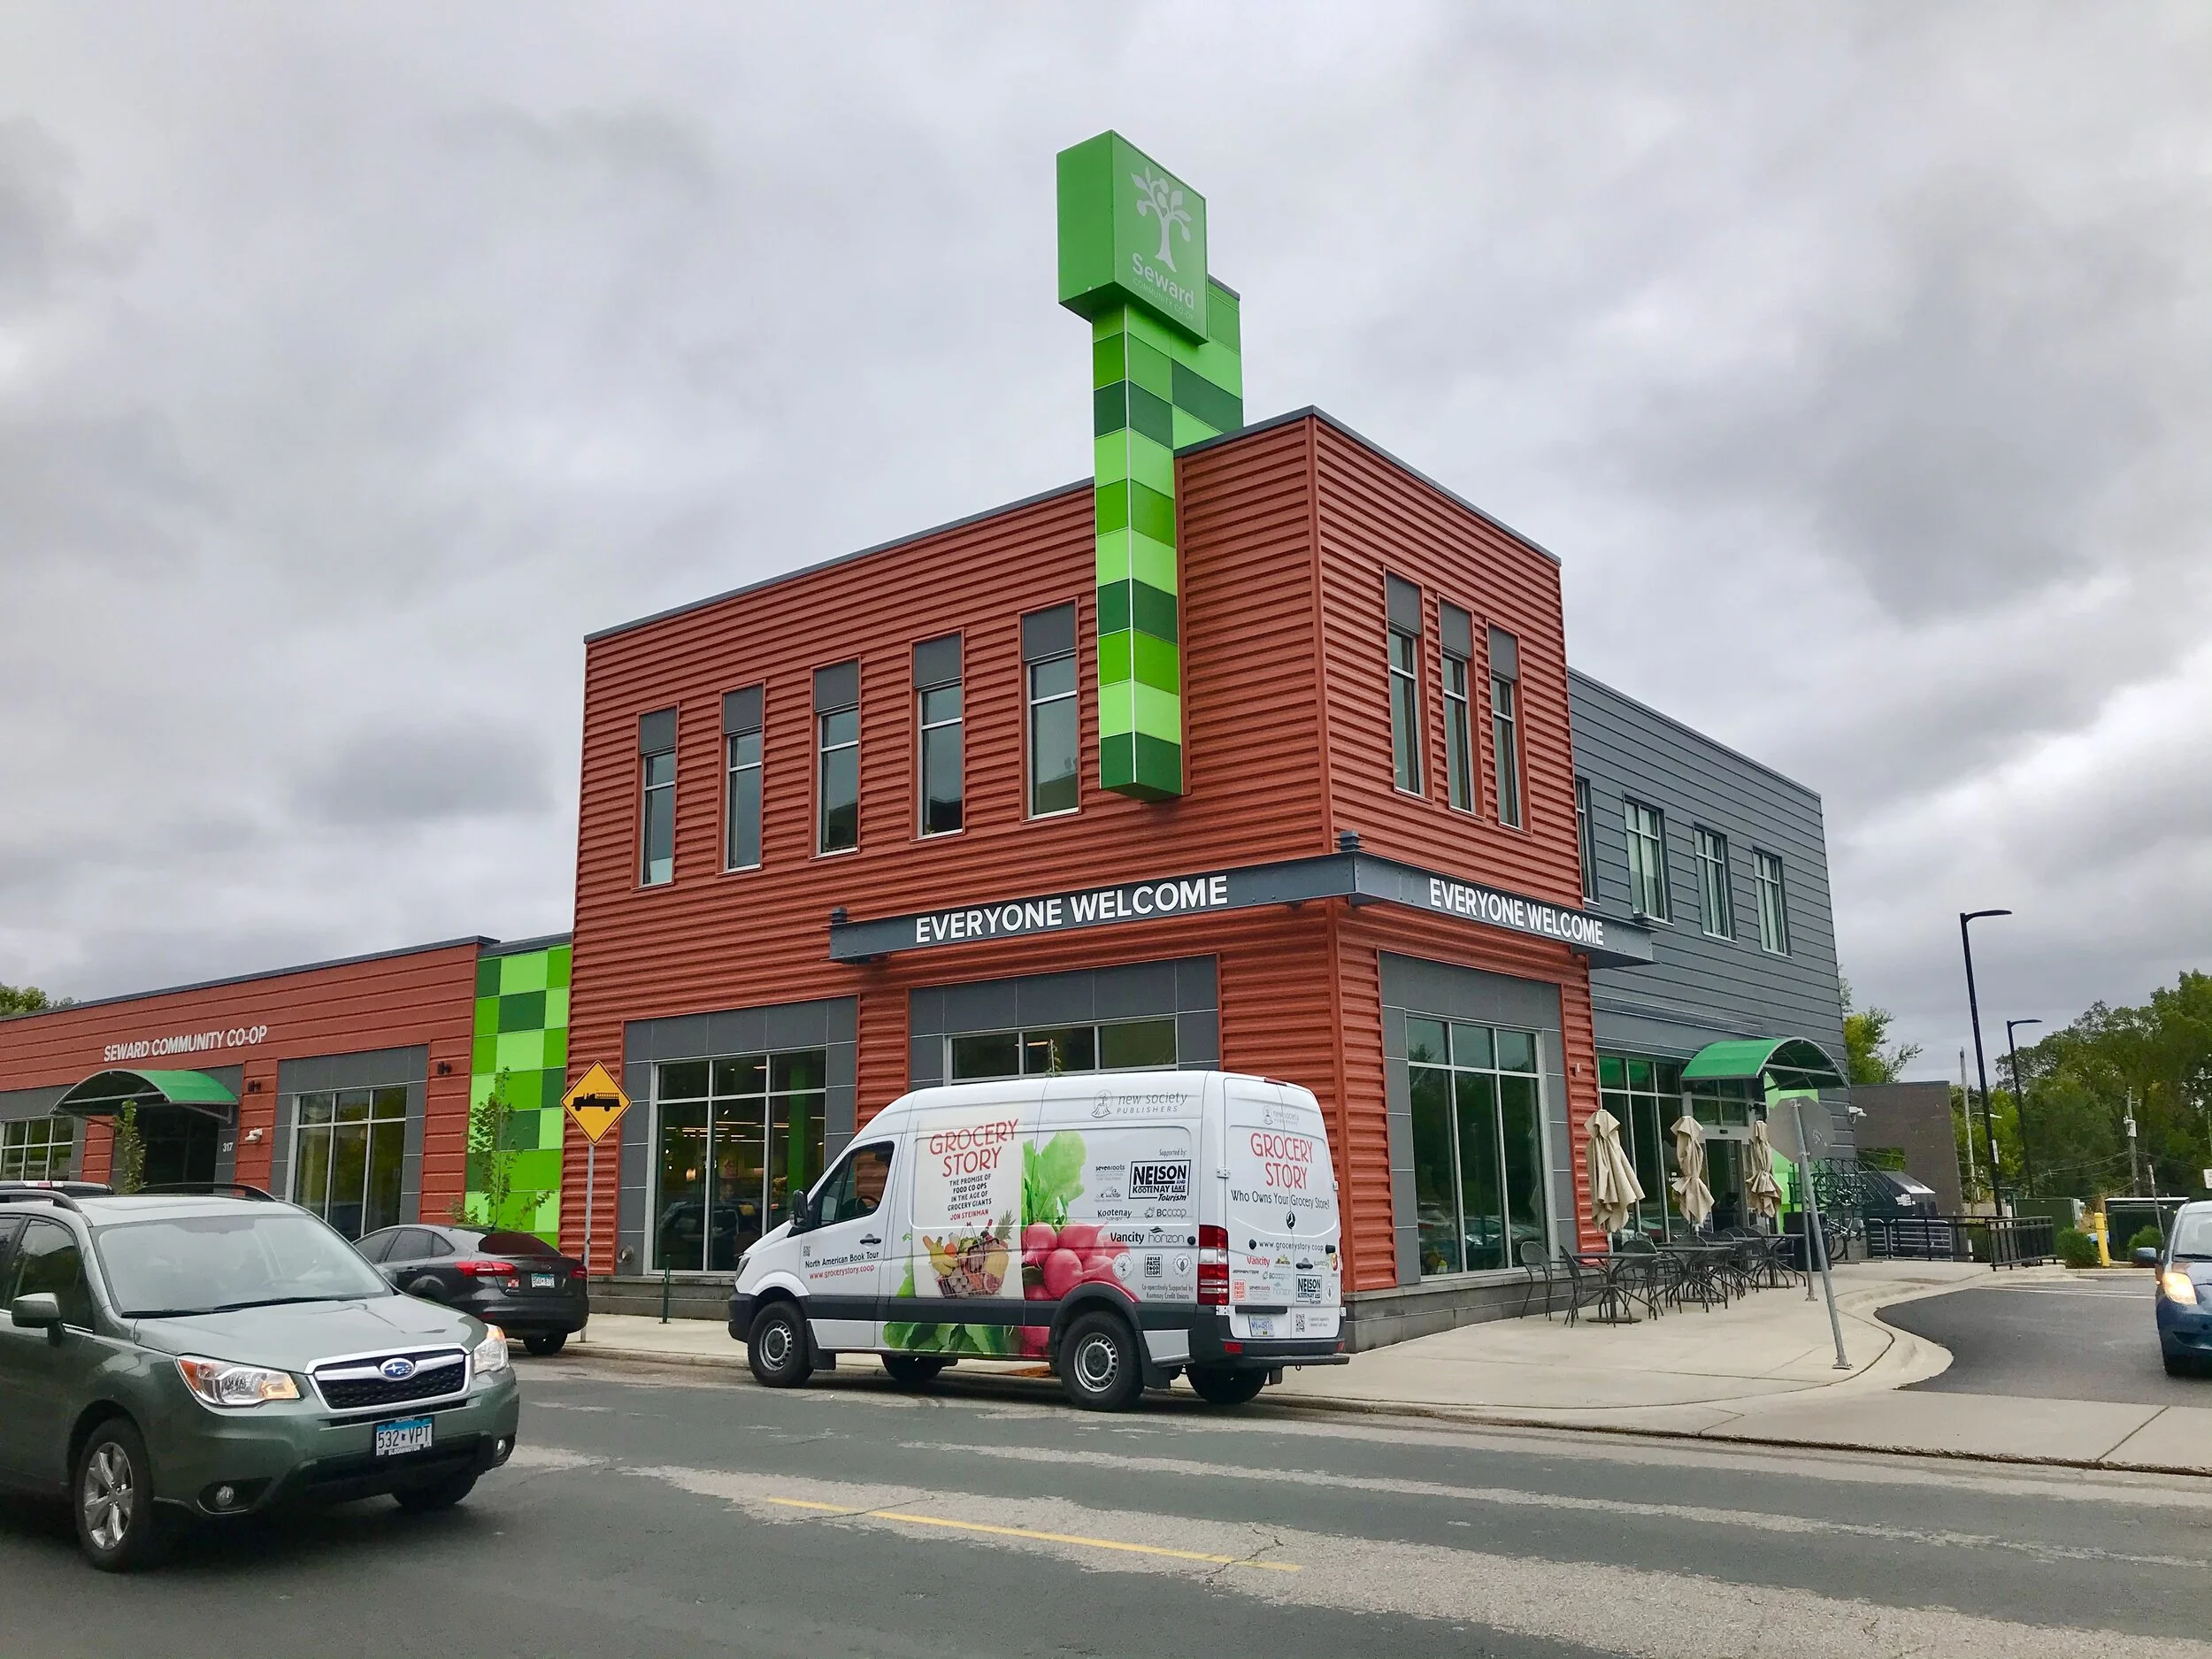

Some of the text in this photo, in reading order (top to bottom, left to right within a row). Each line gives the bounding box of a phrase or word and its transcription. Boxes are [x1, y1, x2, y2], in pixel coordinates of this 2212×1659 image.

[1133, 252, 1194, 311] Seward
[1133, 277, 1173, 306] COMMUNITY
[916, 875, 1228, 943] EVERYONE WELCOME
[1430, 877, 1604, 946] EVERYONE WELCOME
[104, 1025, 267, 1062] SEWARD COMMUNITY CO-OP
[1118, 1092, 1188, 1106] new society
[1117, 1105, 1179, 1115] PUBLISHERS
[929, 1118, 1018, 1155] GROCERY
[222, 1142, 234, 1152] 317
[1250, 1133, 1313, 1164] GROCERY
[942, 1146, 1002, 1178] STORY
[960, 1174, 984, 1185] PROMISE
[1133, 1165, 1187, 1186] NELSON
[1264, 1162, 1308, 1189] STORY
[953, 1186, 967, 1194] FOOD
[969, 1191, 980, 1200] AGE
[1157, 1193, 1187, 1202] Tourism
[947, 1198, 992, 1211] GROCERY GIANTS
[1231, 1189, 1249, 1202] Who
[1252, 1191, 1272, 1204] Owns
[1273, 1193, 1288, 1205] Your
[1290, 1194, 1314, 1209] Grocery
[962, 1208, 989, 1219] STEINMAN
[1097, 1209, 1133, 1219] Kootenay
[1110, 1232, 1145, 1245] Vancity
[1148, 1232, 1185, 1243] horizon
[805, 1251, 879, 1269] North American Book Tour
[1246, 1256, 1271, 1268] Vancity
[810, 1263, 875, 1280] www.grocerystory.coop
[1297, 1278, 1321, 1293] NELSON
[378, 1425, 431, 1449] 532 VPT
